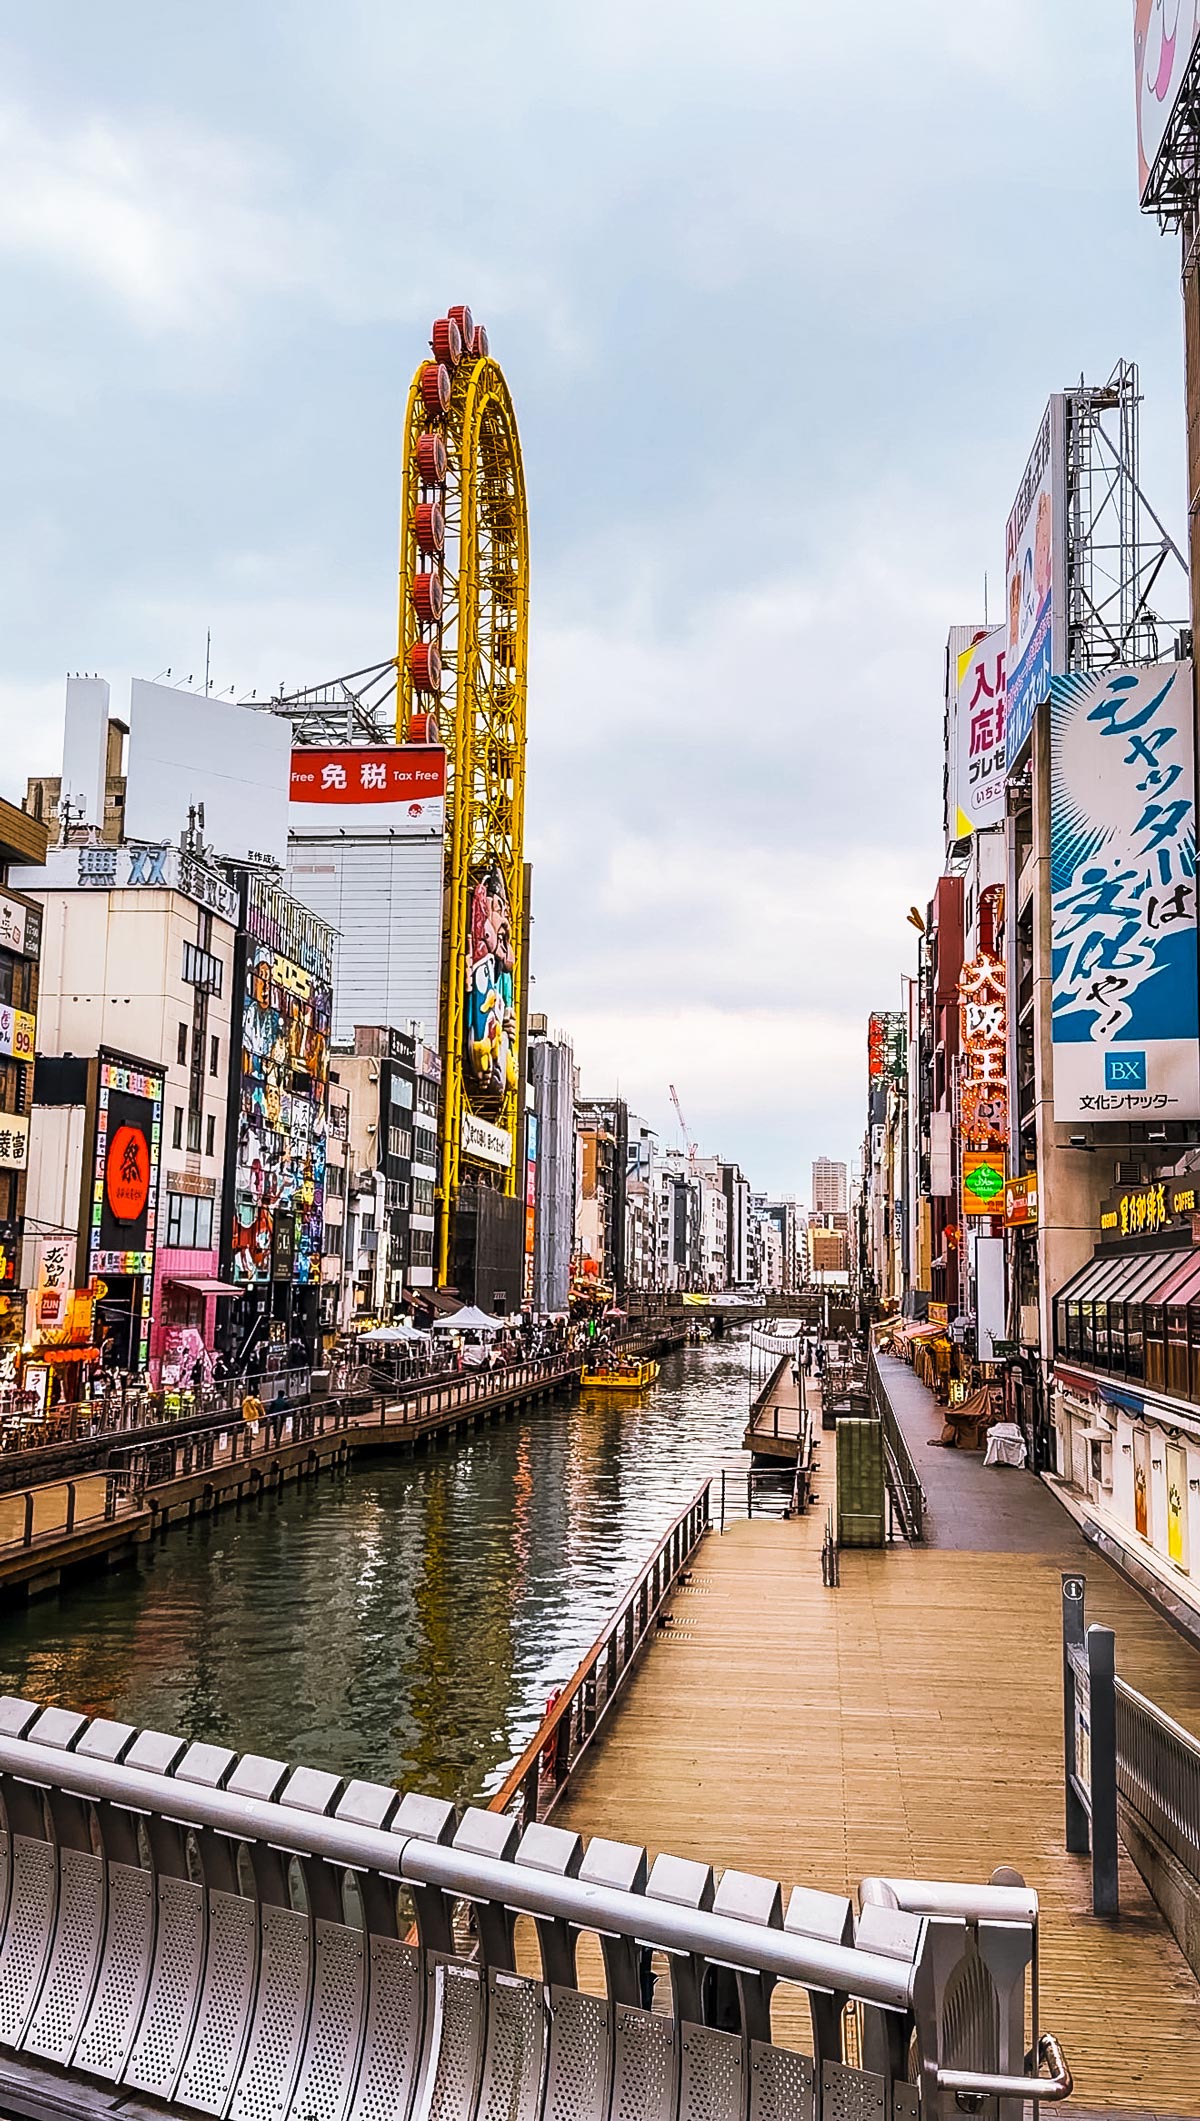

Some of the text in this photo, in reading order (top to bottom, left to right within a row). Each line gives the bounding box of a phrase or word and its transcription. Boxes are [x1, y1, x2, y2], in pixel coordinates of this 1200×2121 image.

[291, 763, 439, 790] Free 免税 Tax Free
[16, 1031, 30, 1053] 99
[1110, 1061, 1142, 1080] BX
[1174, 1190, 1195, 1213] COFFEE
[42, 1300, 59, 1310] ZUN
